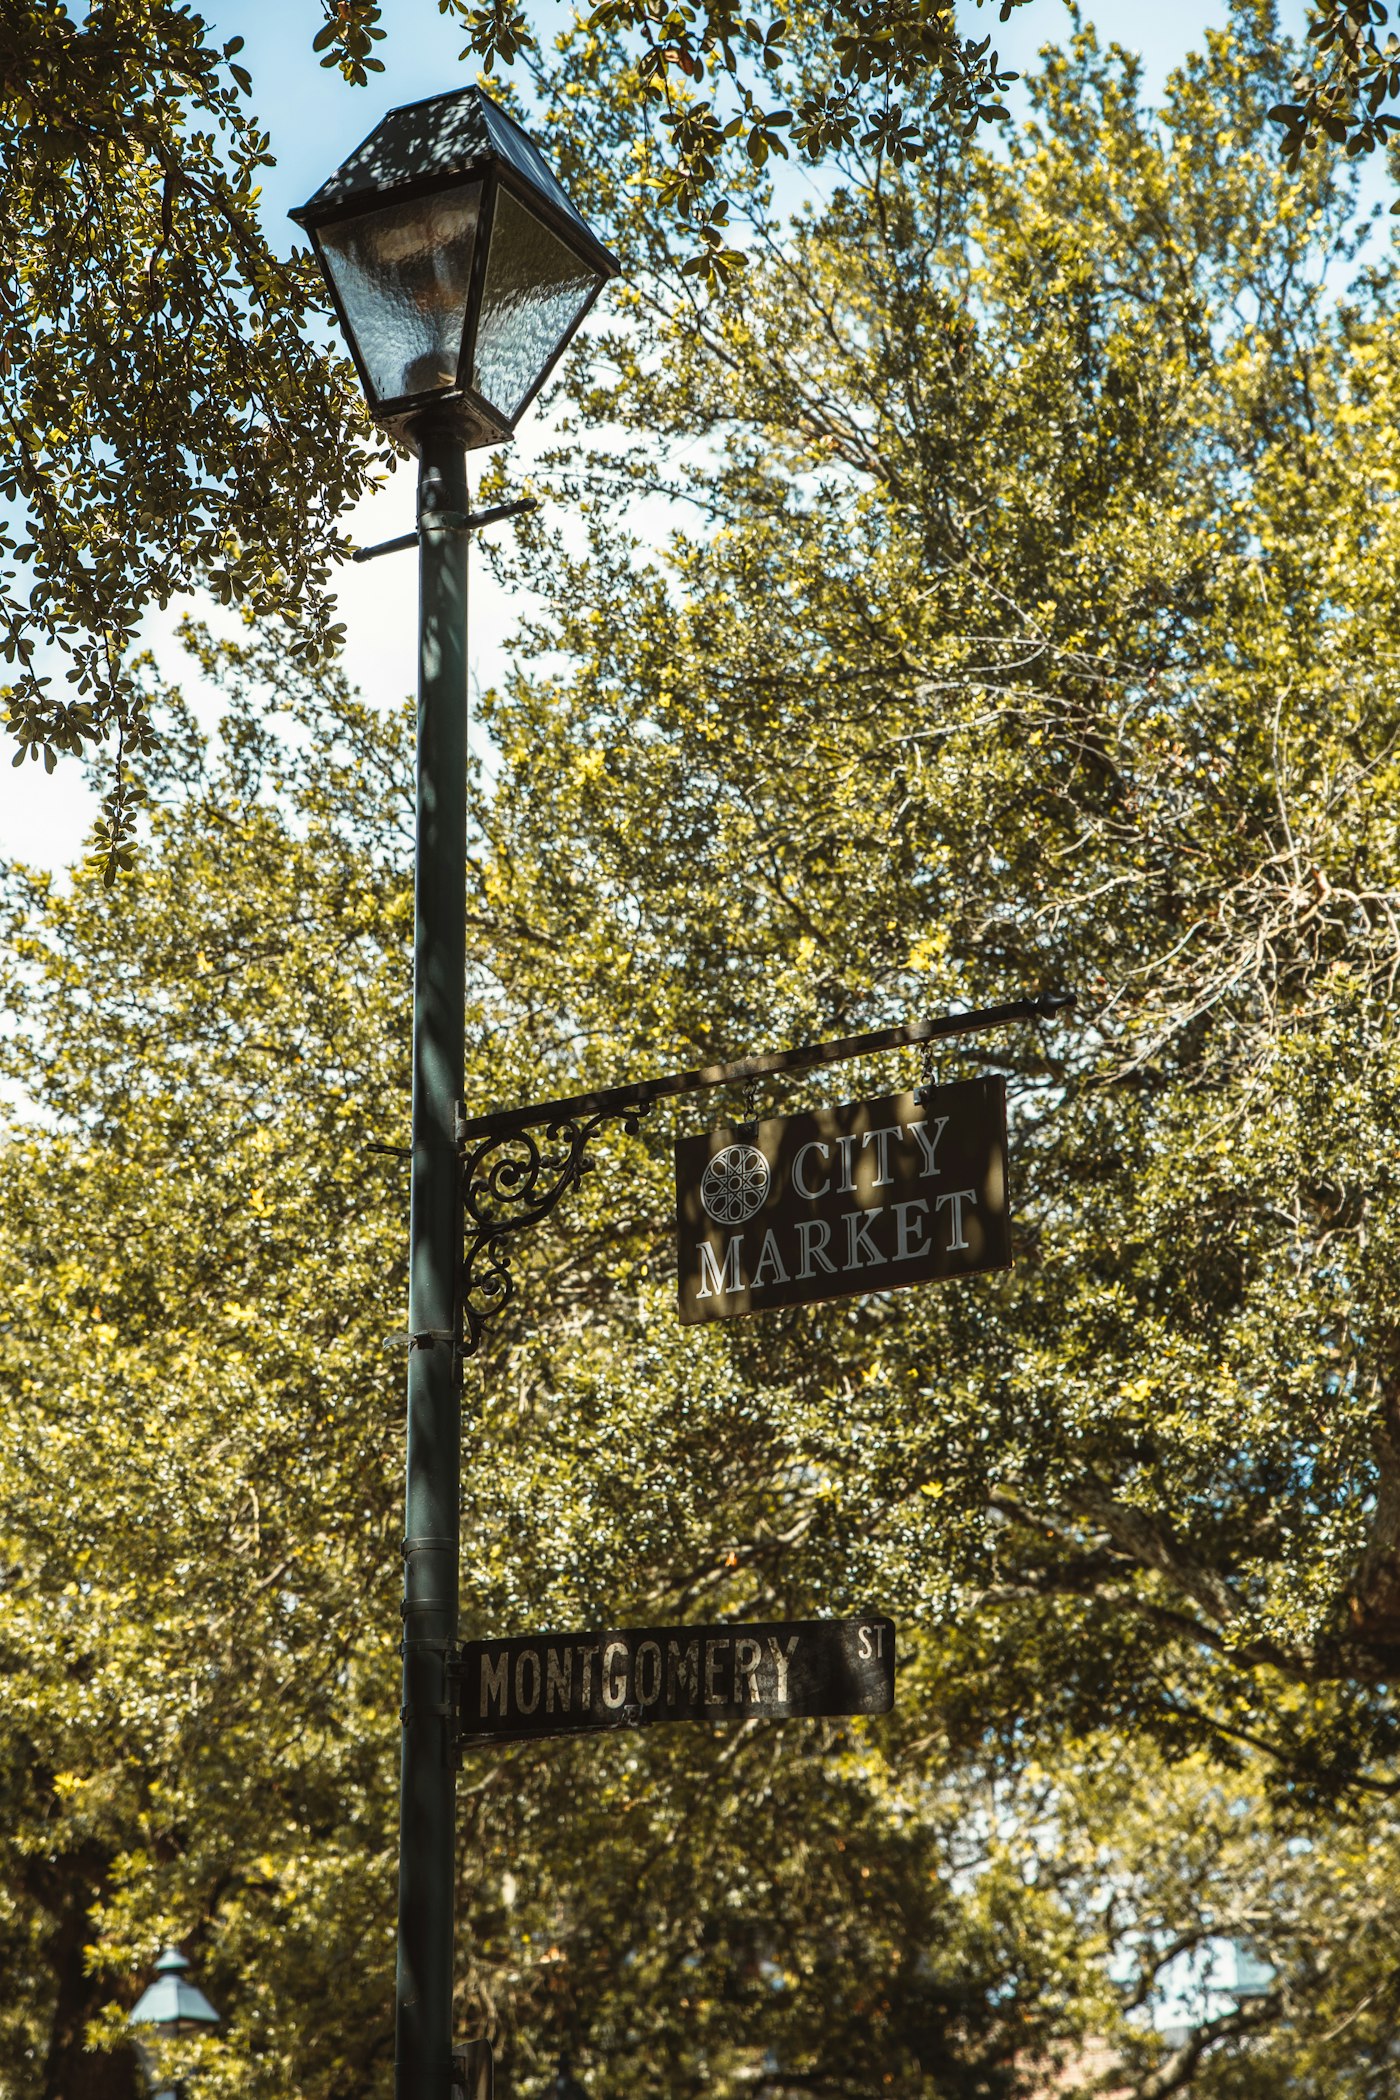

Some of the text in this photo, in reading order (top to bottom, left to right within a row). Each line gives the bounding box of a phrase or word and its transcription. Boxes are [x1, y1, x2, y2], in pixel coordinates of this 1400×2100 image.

[792, 1116, 950, 1200] CITY
[695, 1188, 978, 1299] MARKET
[479, 1624, 887, 1718] MONTGOMERY ST
